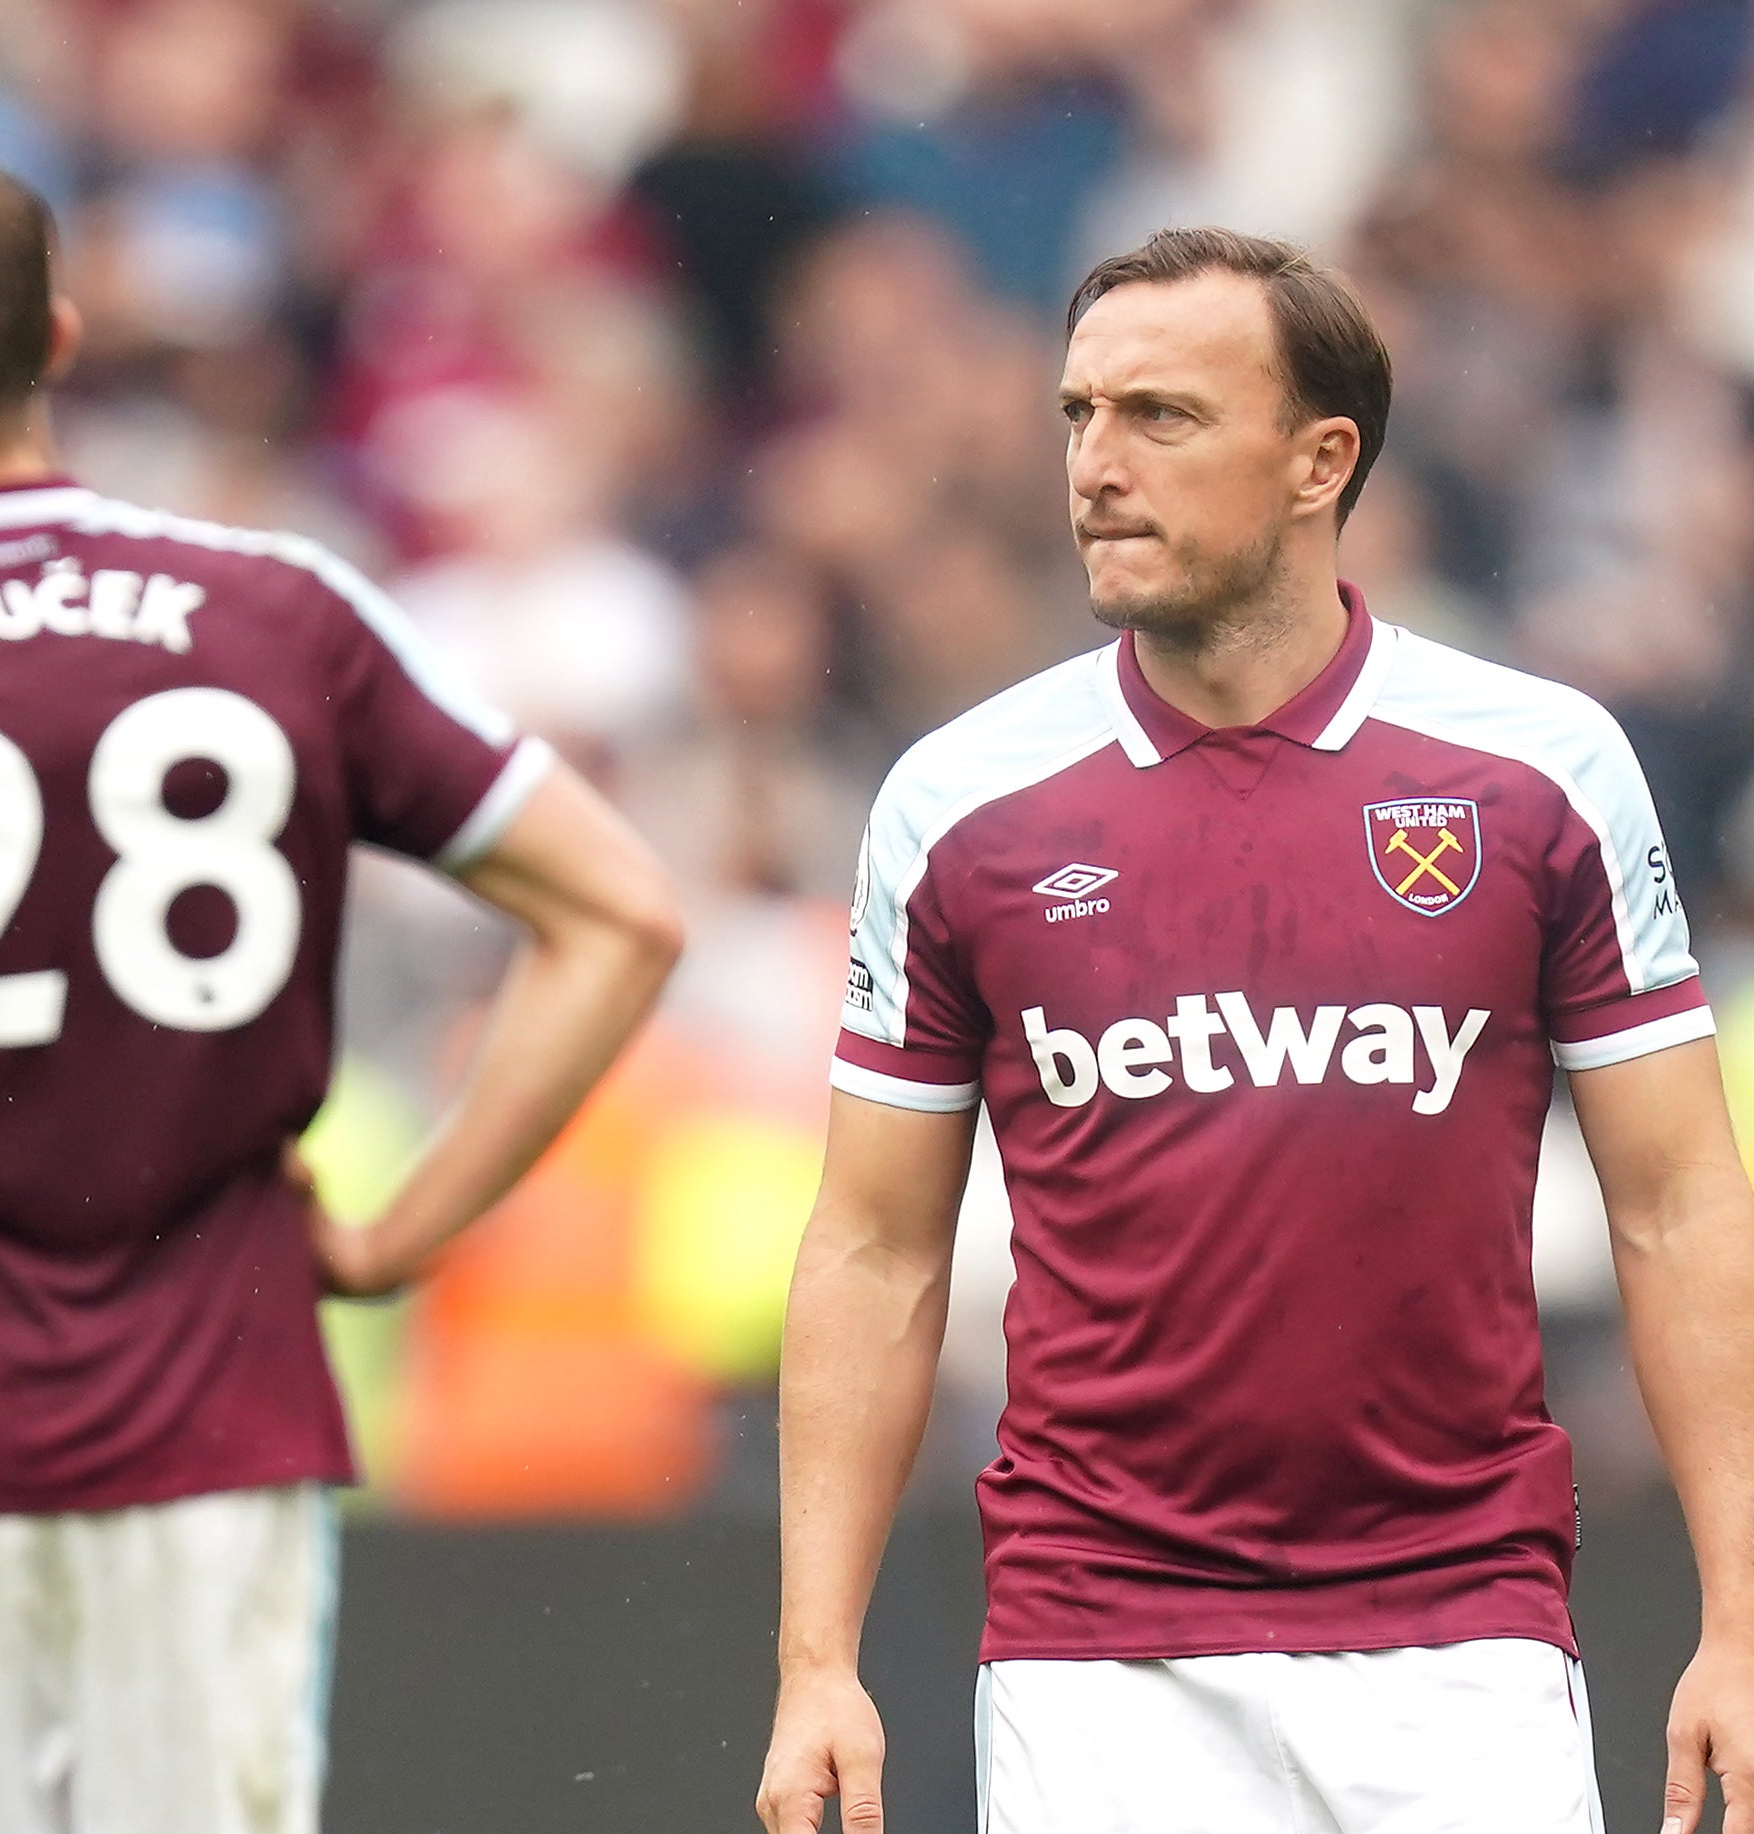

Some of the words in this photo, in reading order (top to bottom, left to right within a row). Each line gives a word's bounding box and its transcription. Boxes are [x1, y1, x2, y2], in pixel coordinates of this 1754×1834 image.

[1374, 804, 1422, 821] WEST
[1422, 804, 1466, 819] HAM
[1394, 815, 1448, 828] UNITED
[1408, 893, 1449, 906] LONDON
[1044, 898, 1111, 924] umbro
[1020, 991, 1491, 1115] betway
